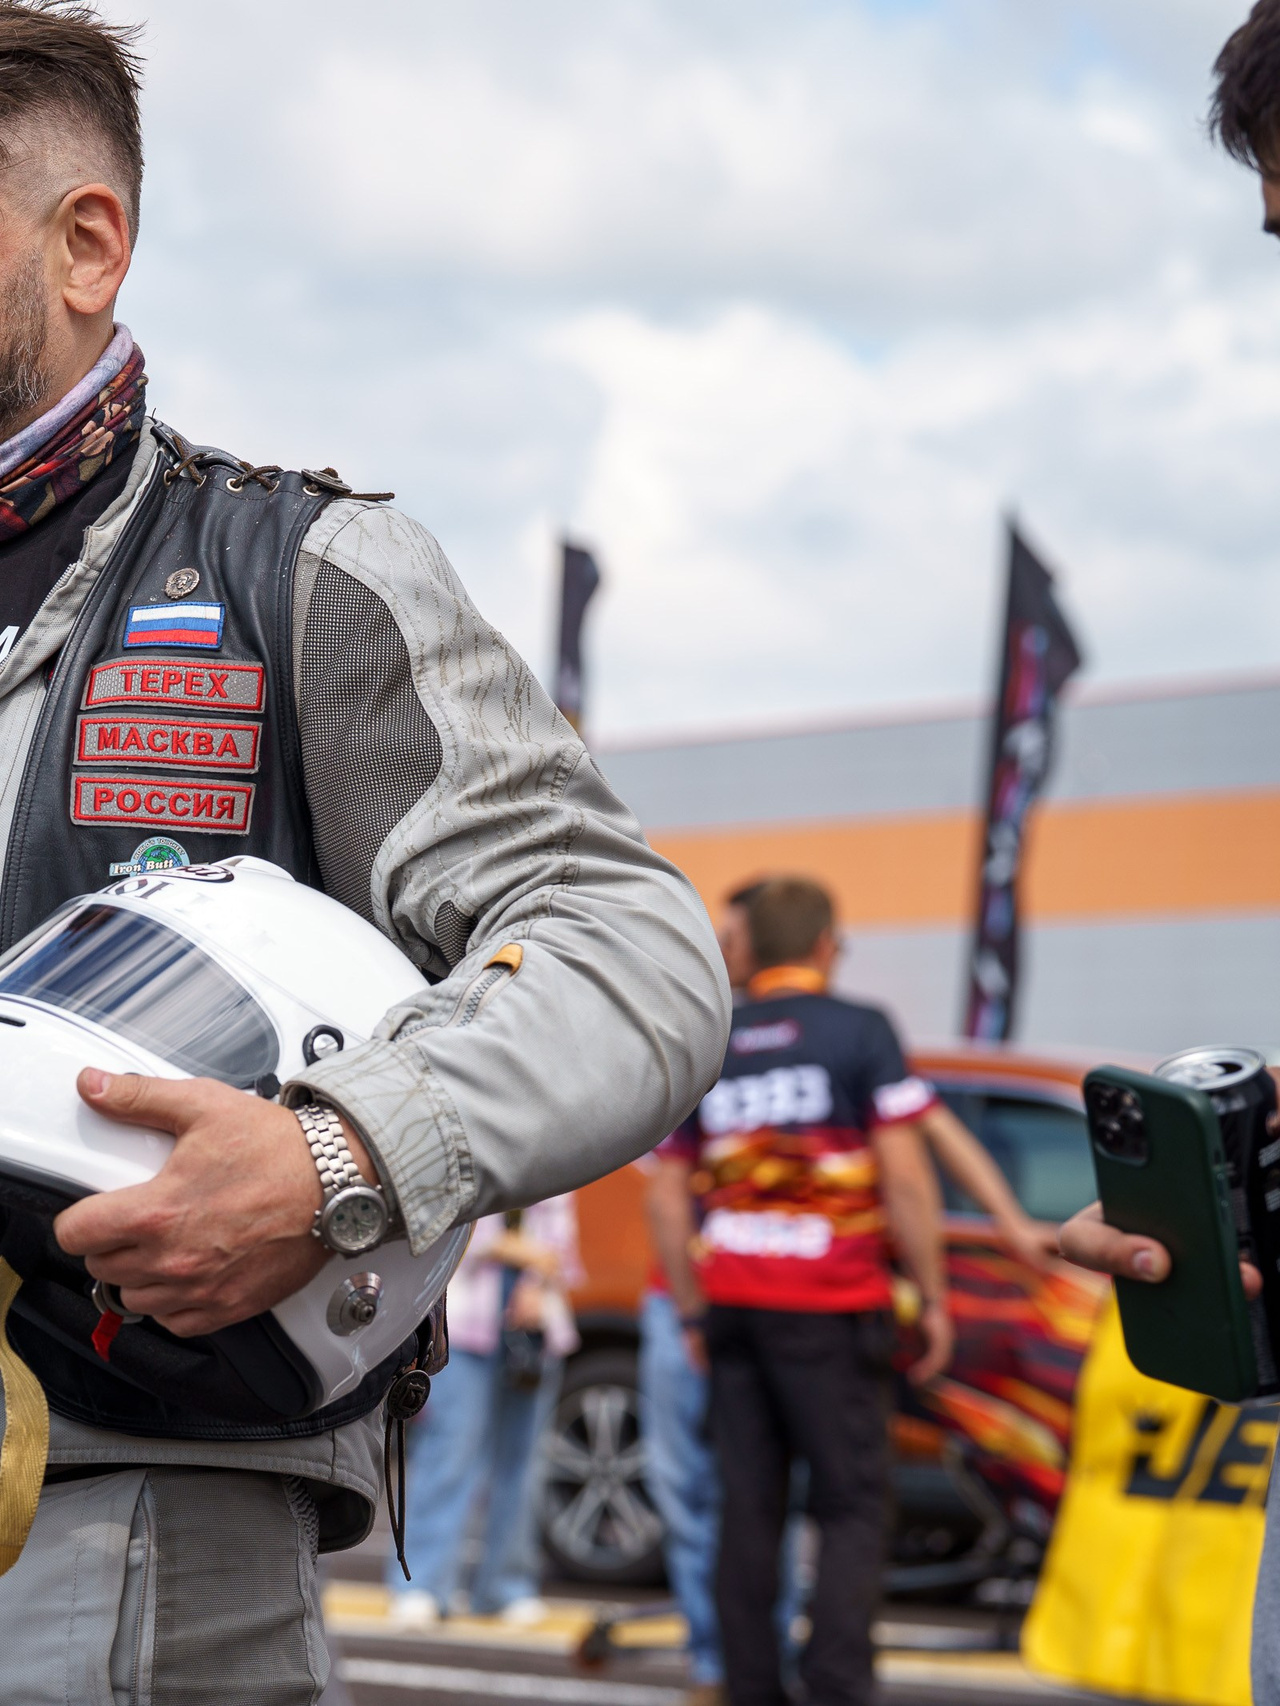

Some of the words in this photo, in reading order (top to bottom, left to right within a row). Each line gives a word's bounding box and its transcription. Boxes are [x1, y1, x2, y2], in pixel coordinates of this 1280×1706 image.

[120, 669, 229, 698] ТЕРЕХ
[97, 726, 240, 758] МАСКВА
[93, 786, 236, 819] РОССИЯ
[113, 863, 142, 875] Iron
[145, 859, 174, 871] Butt
